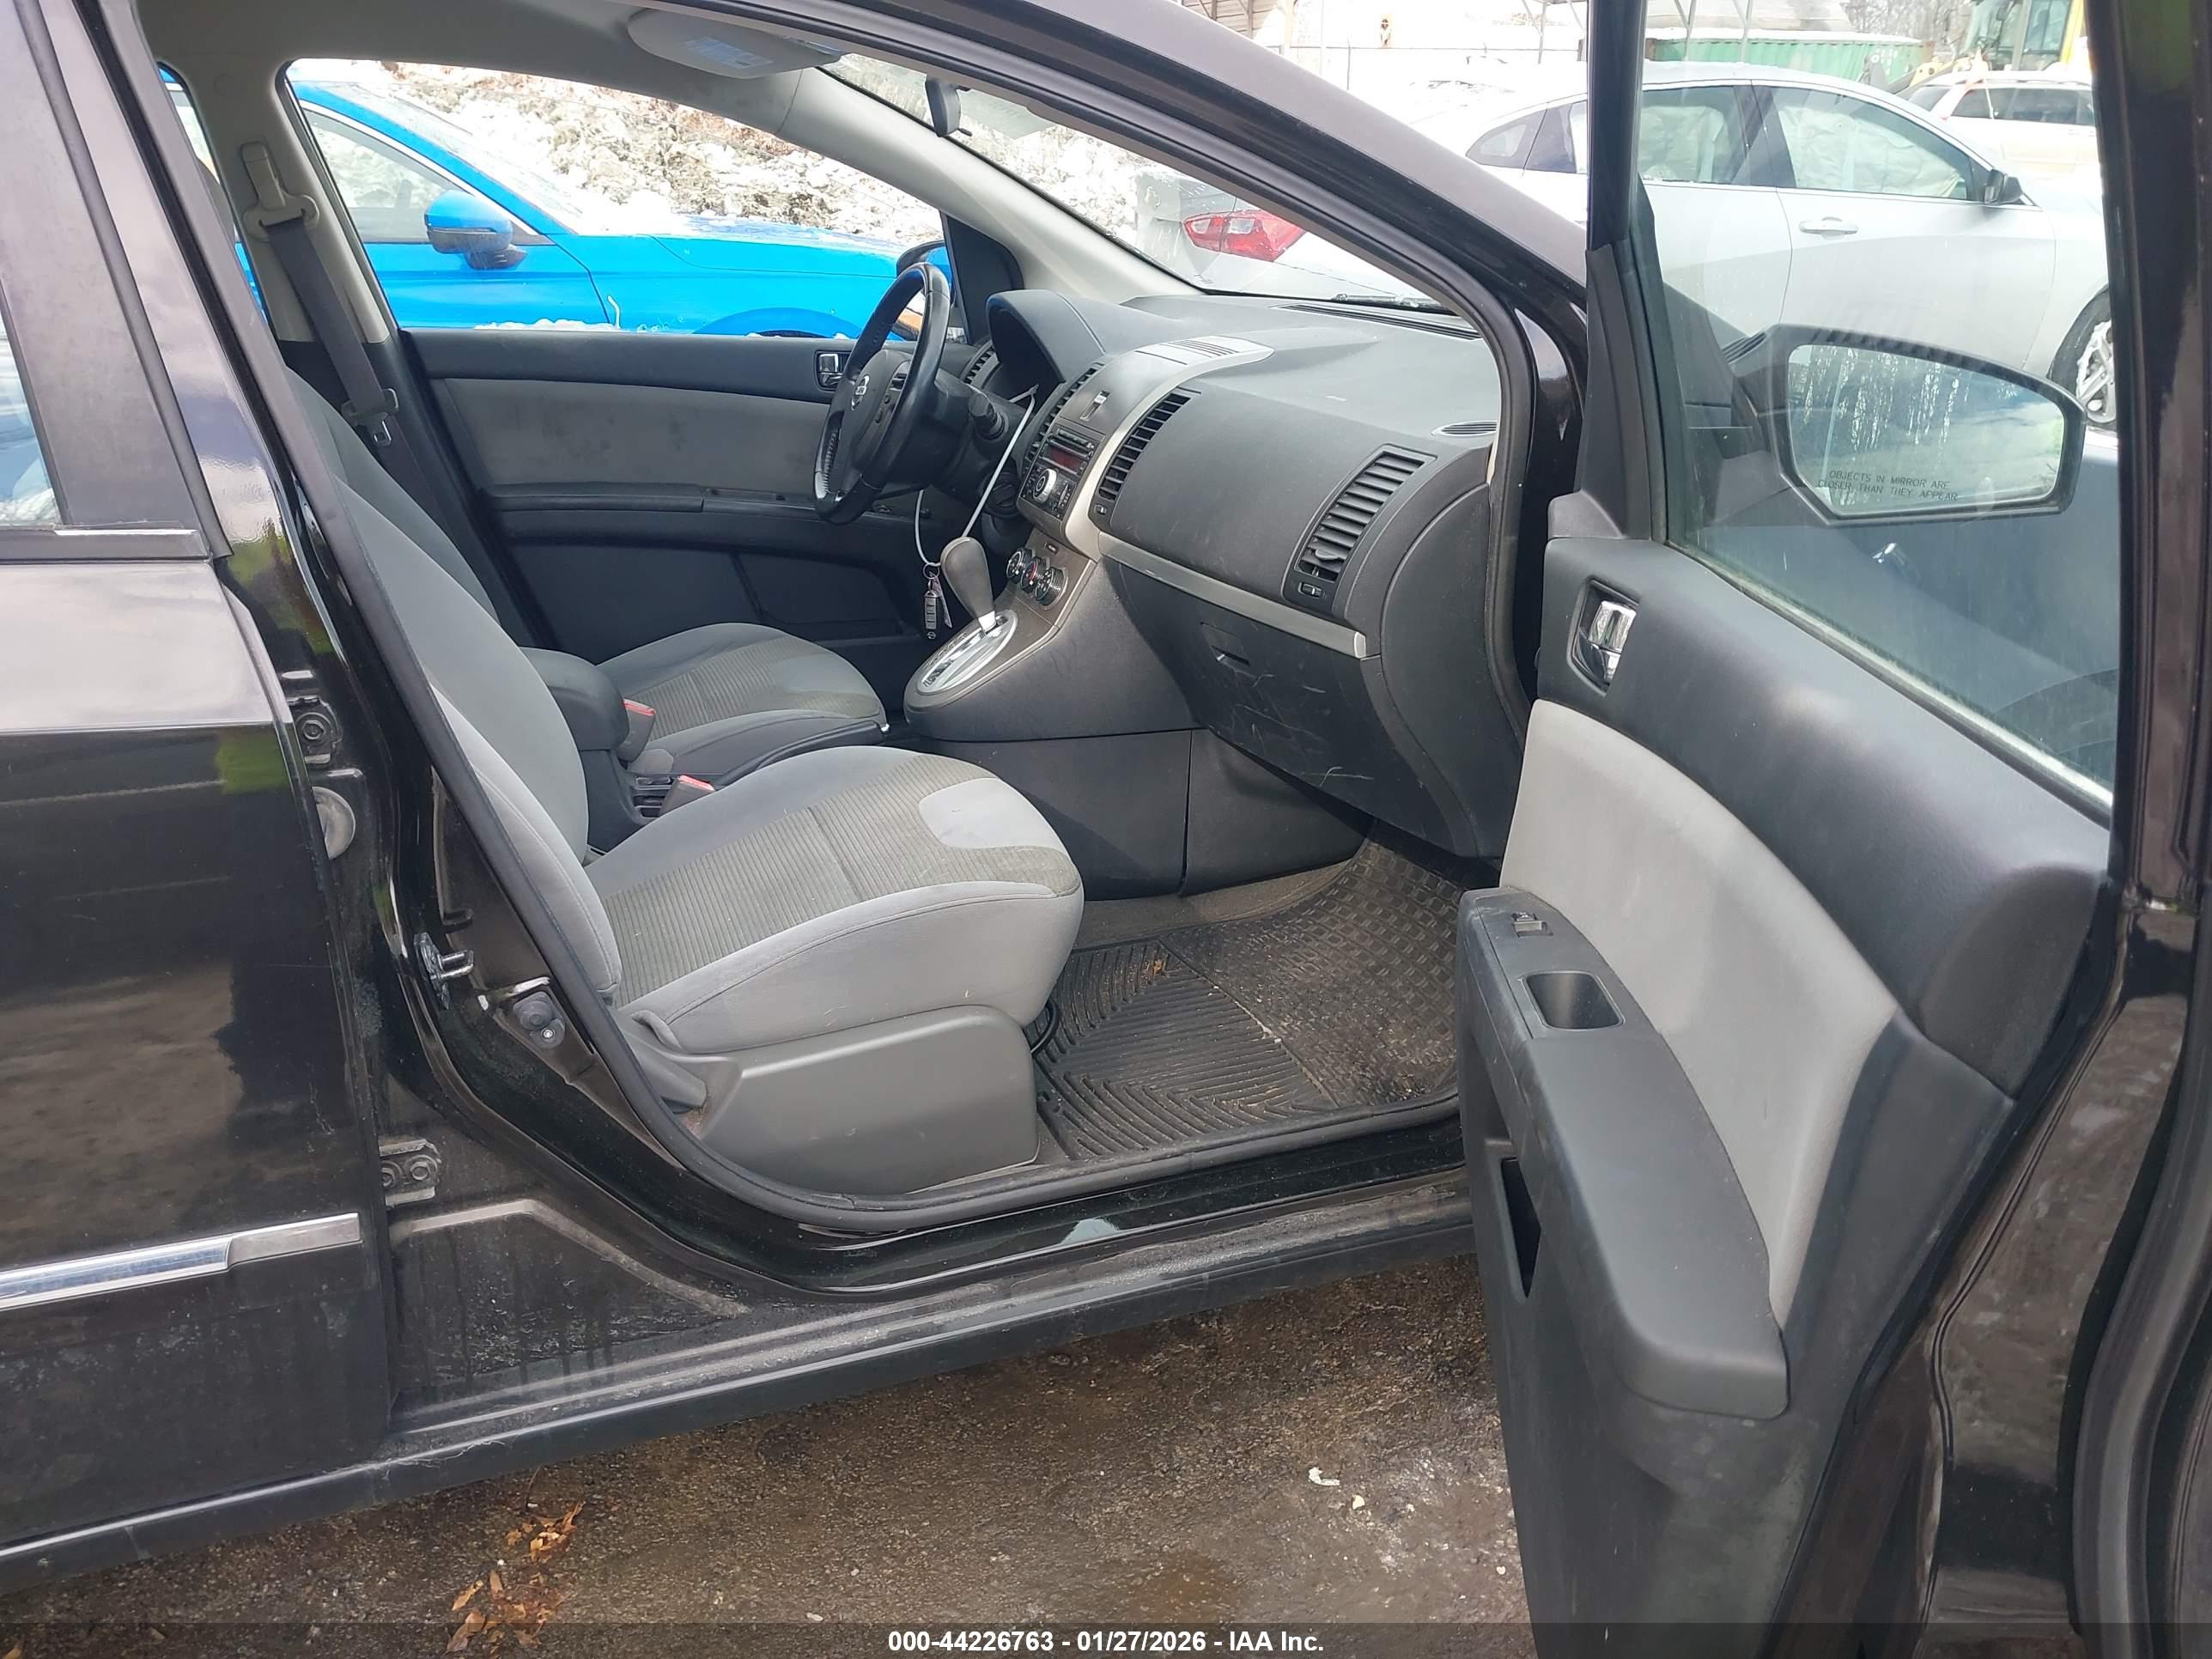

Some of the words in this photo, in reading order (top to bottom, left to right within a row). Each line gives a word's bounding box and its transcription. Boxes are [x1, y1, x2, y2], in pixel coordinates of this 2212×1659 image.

[1829, 470, 1871, 483] OBJECTS
[1875, 474, 1886, 484] IN
[1890, 476, 1927, 488] MIRROR
[1930, 480, 1951, 489] ARE
[1818, 479, 1852, 492] CLOSER
[1859, 483, 1883, 494] THAN
[1890, 487, 1912, 497] THEY
[1918, 489, 1958, 501] APPEAR
